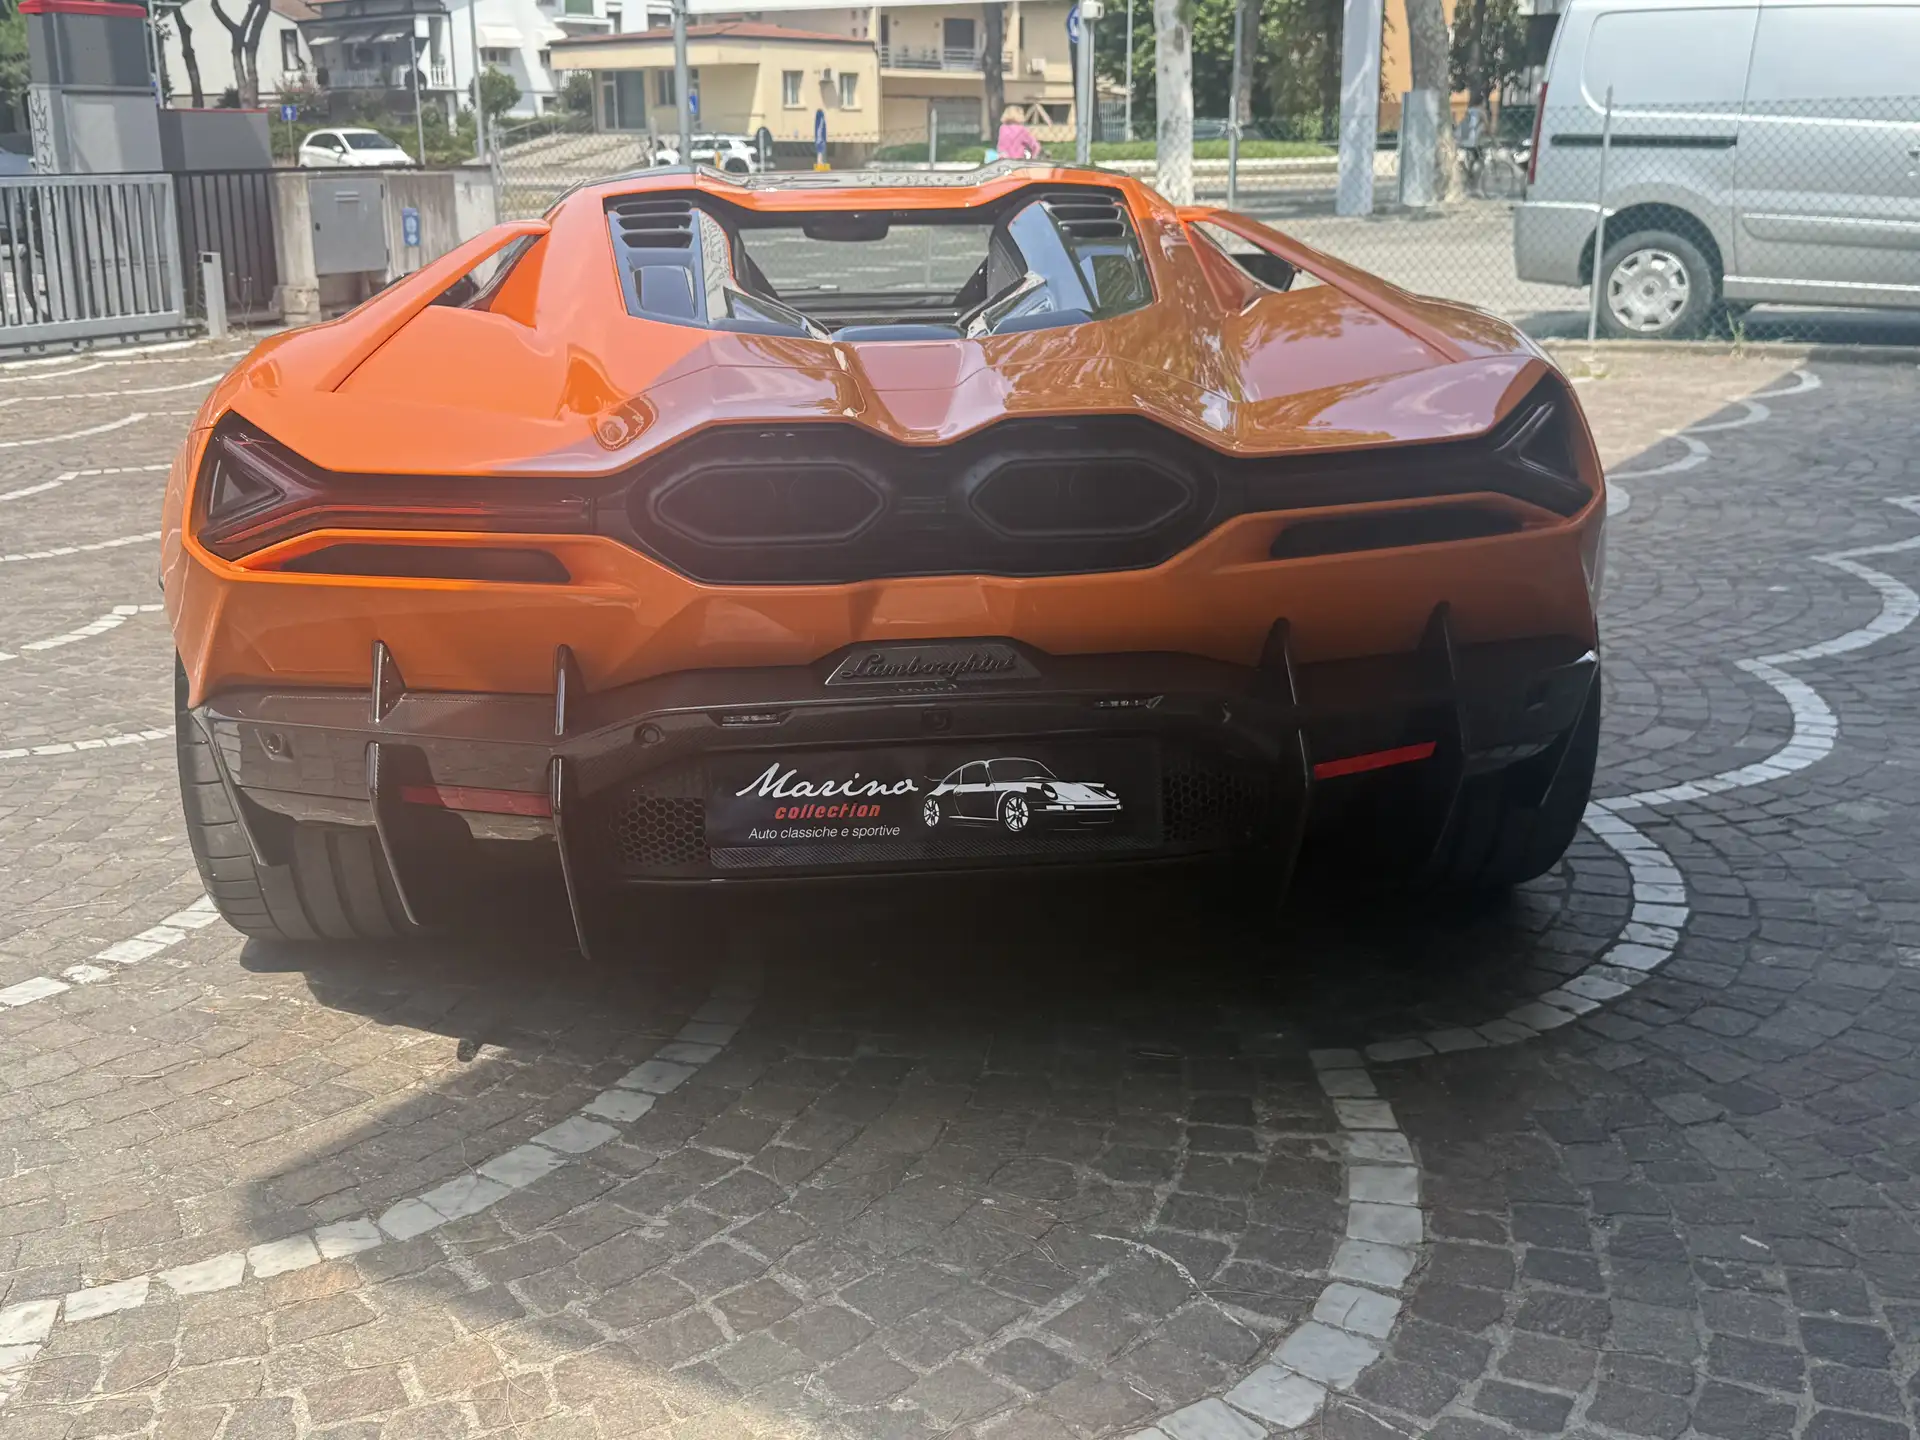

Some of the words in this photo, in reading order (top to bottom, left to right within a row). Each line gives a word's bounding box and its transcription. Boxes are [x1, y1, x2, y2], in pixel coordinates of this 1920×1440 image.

[840, 652, 1016, 678] Lamborghini
[735, 763, 919, 798] Marino
[775, 803, 881, 820] collection
[748, 827, 777, 840] Auto
[780, 826, 838, 839] classiche
[840, 828, 849, 837] e
[852, 825, 900, 839] sportive
